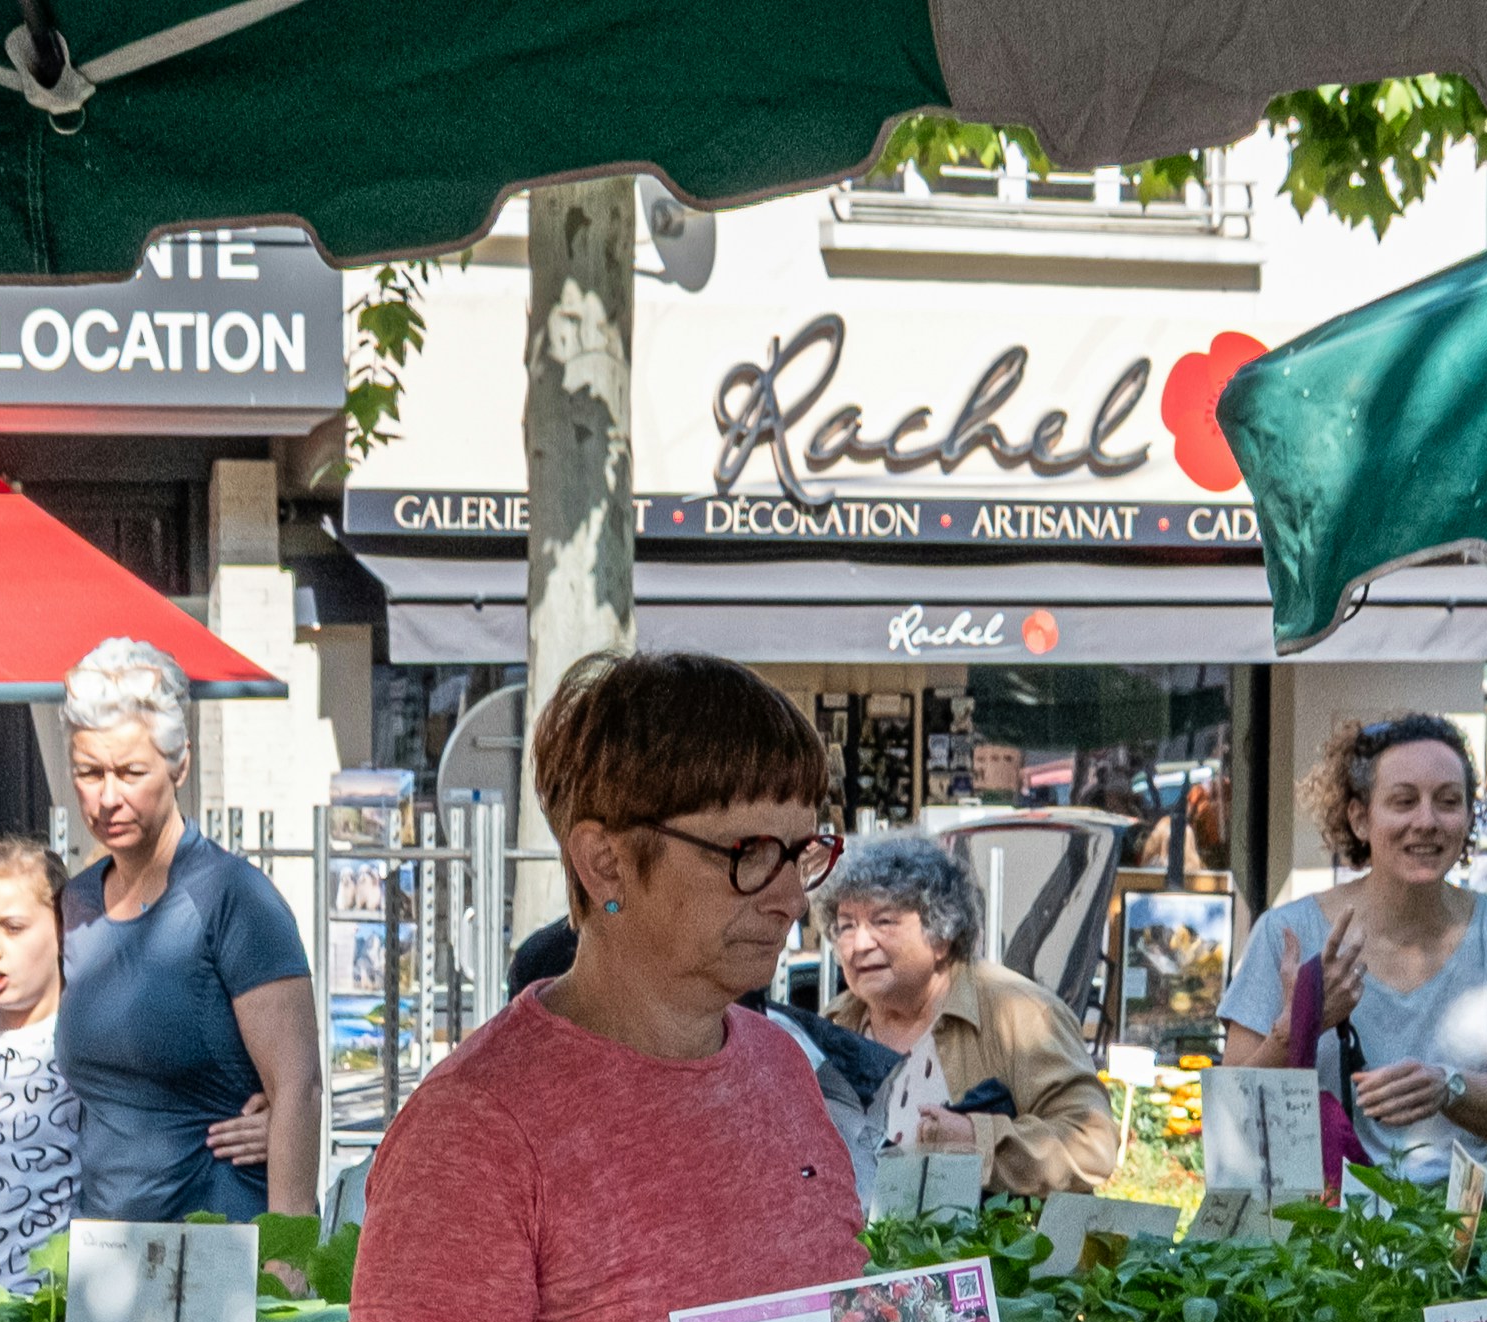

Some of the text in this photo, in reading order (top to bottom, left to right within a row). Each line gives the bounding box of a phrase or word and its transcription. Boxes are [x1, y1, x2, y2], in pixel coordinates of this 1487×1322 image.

[714, 313, 1153, 512] Rachel
[704, 495, 1263, 543] DÉCORATION ARTISANAT CAD
[887, 604, 1005, 656] Rachel
